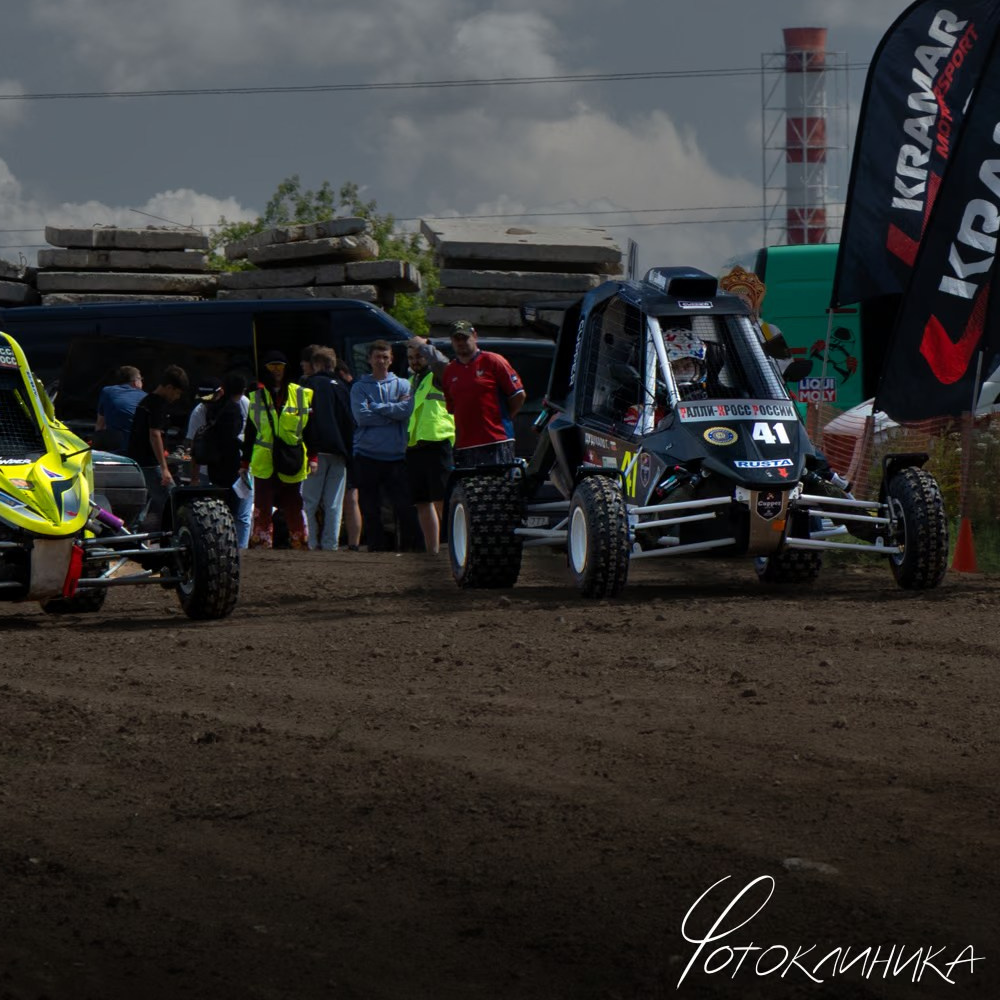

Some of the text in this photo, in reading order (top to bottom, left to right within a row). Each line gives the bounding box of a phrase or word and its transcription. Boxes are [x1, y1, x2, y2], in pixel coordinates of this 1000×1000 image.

[891, 9, 969, 212] KRAMAR
[938, 121, 1000, 300] KRA
[799, 378, 835, 391] LIQUI
[799, 390, 835, 402] MOLY
[680, 404, 794, 419] РАЛЛИ-КРОСС РОССИИ
[752, 422, 791, 445] 41
[738, 459, 792, 468] RUSTA
